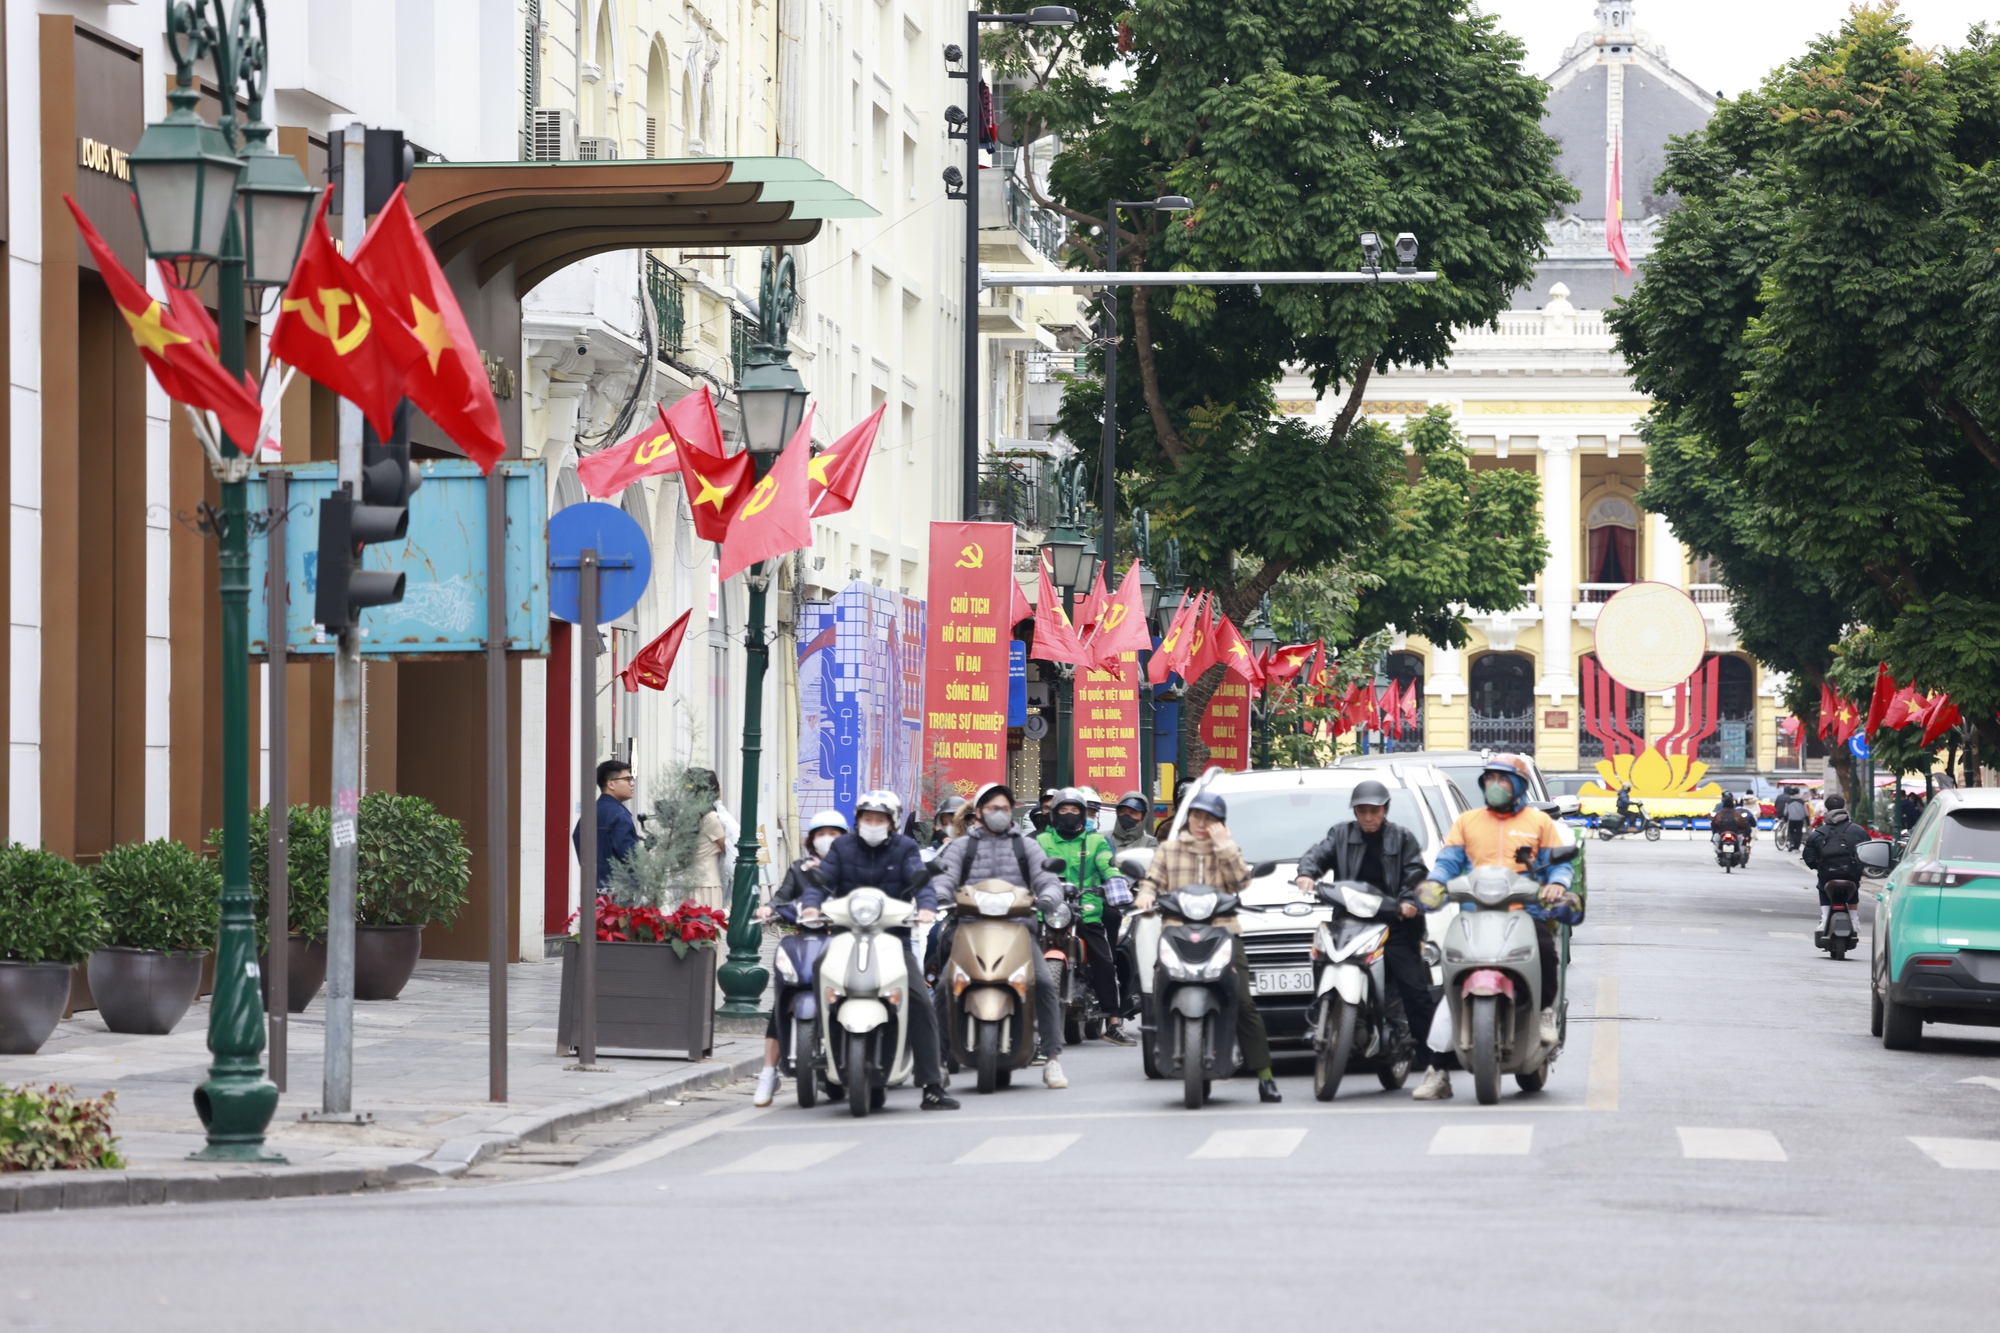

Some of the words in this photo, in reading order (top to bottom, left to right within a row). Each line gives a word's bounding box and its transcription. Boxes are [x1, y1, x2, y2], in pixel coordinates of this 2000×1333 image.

[82, 137, 110, 174] LOUIS
[950, 591, 968, 614] CHỦ
[969, 597, 990, 618] TỊCH
[942, 620, 954, 642] HỒ
[956, 622, 971, 643] CHÍ
[972, 626, 996, 644] MINH
[956, 652, 964, 672] VĨ
[966, 655, 981, 676] ĐẠI
[1121, 651, 1136, 662] NAM
[946, 678, 970, 701] SỐNG
[972, 682, 989, 702] MÃI
[1105, 687, 1118, 703] VIỆT
[1119, 690, 1134, 700] NAM
[928, 712, 957, 730] TRONG
[958, 712, 972, 734] SỰ
[972, 711, 1004, 735] NGHIỆP
[1106, 726, 1119, 741] VIỆT
[1120, 728, 1134, 739] NAM
[952, 739, 983, 760] CHÚNG
[984, 743, 998, 760] TA!
[1088, 764, 1104, 778] PHÁT
